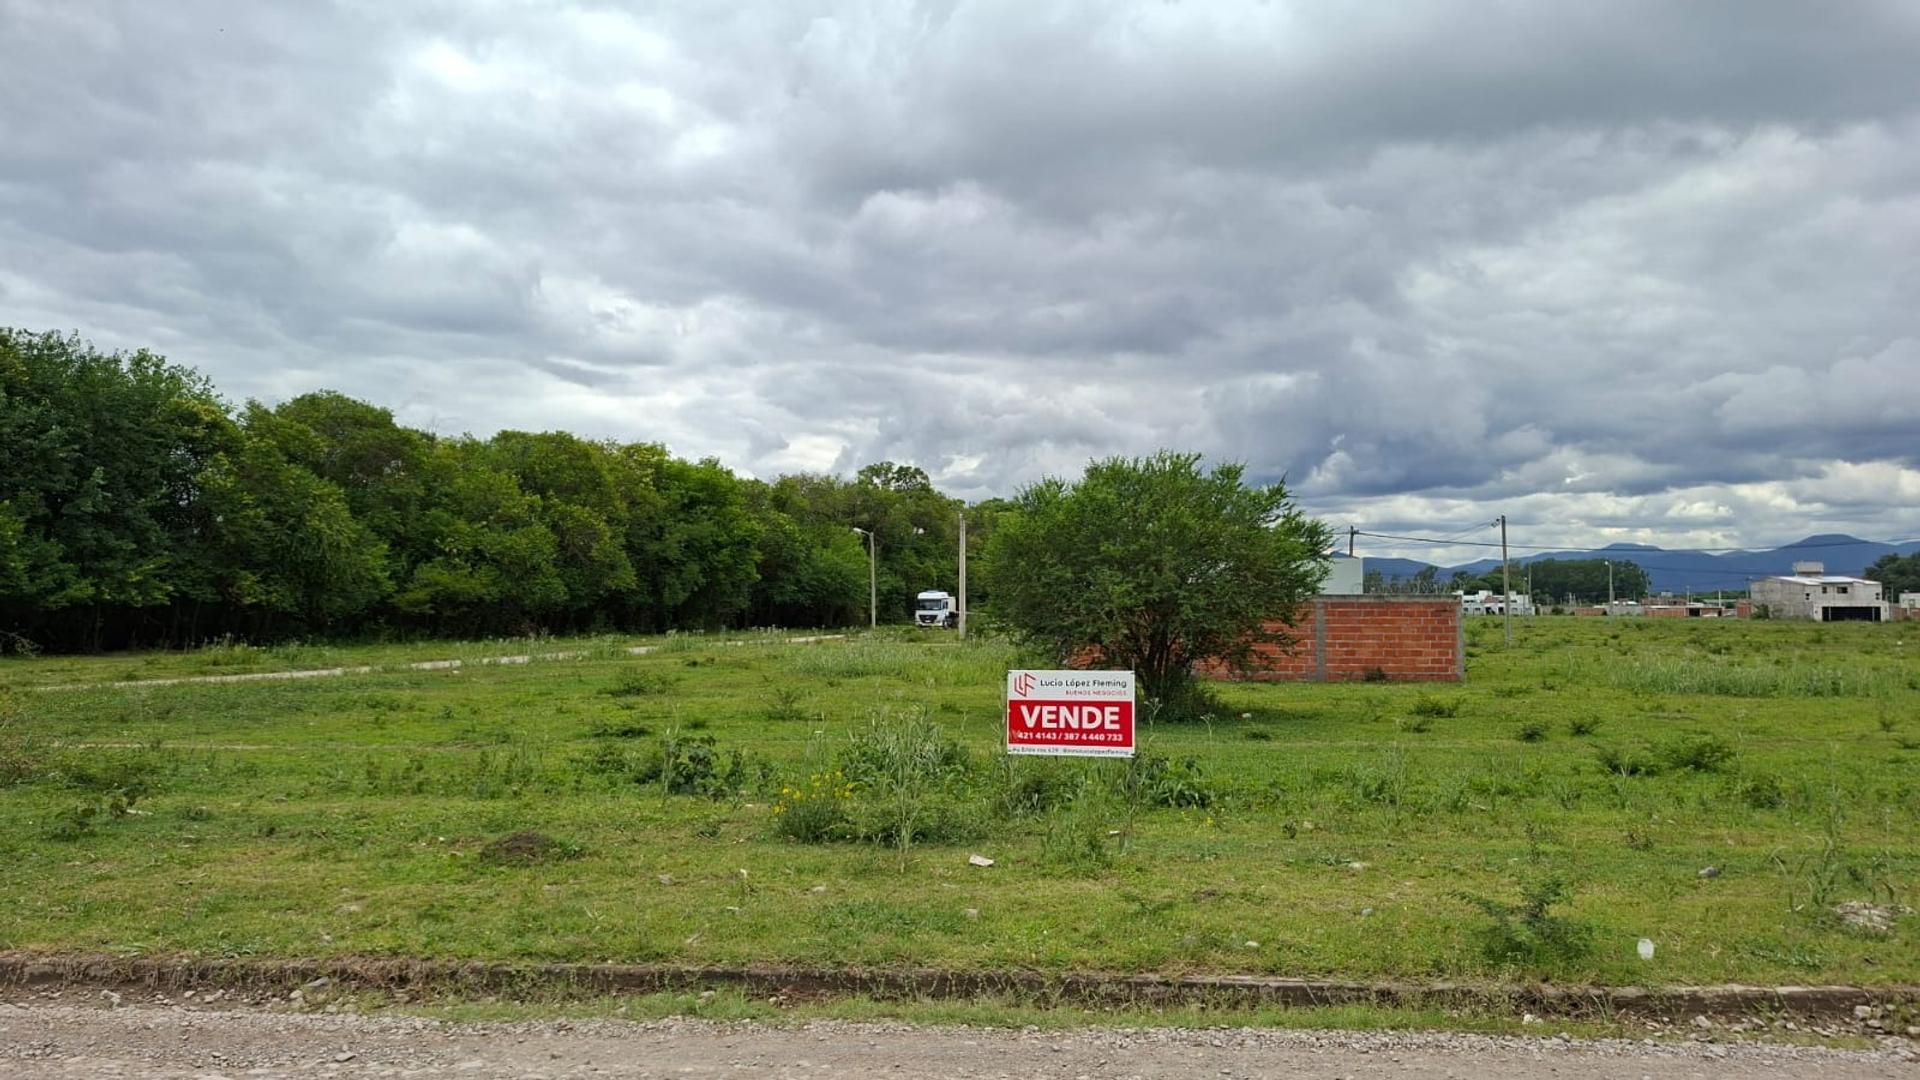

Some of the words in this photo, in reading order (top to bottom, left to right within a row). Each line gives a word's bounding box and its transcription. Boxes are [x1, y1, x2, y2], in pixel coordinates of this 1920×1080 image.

[1040, 678, 1063, 687] Lucio
[1065, 678, 1090, 688] López
[1092, 678, 1127, 689] Fleming
[1020, 705, 1120, 730] VENDE
[1035, 732, 1056, 740] 4143
